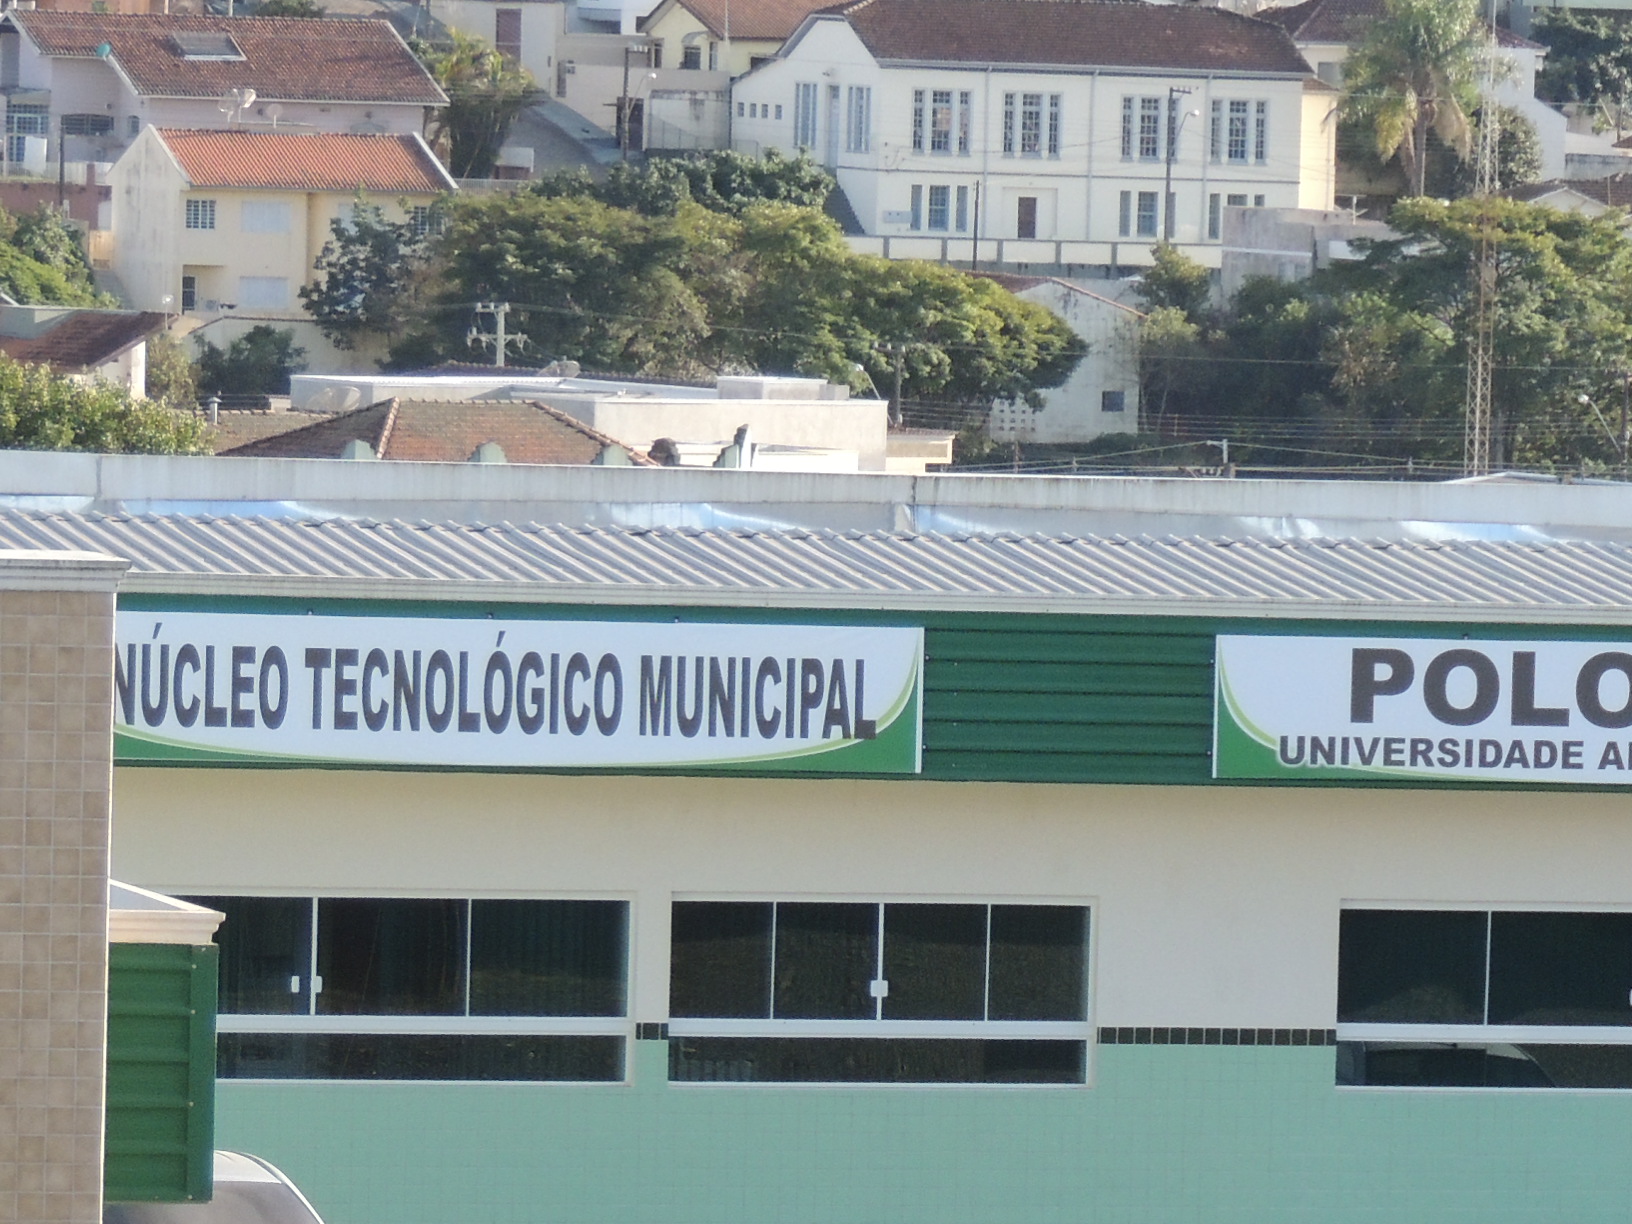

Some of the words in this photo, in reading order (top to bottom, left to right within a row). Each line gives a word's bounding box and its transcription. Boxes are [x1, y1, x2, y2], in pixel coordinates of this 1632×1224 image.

[115, 622, 289, 730] NÚCLEO
[304, 630, 623, 737] TECNOLÓGICO
[639, 655, 877, 740] MUNICIPAL
[1279, 735, 1584, 769] UNIVERSIDADE
